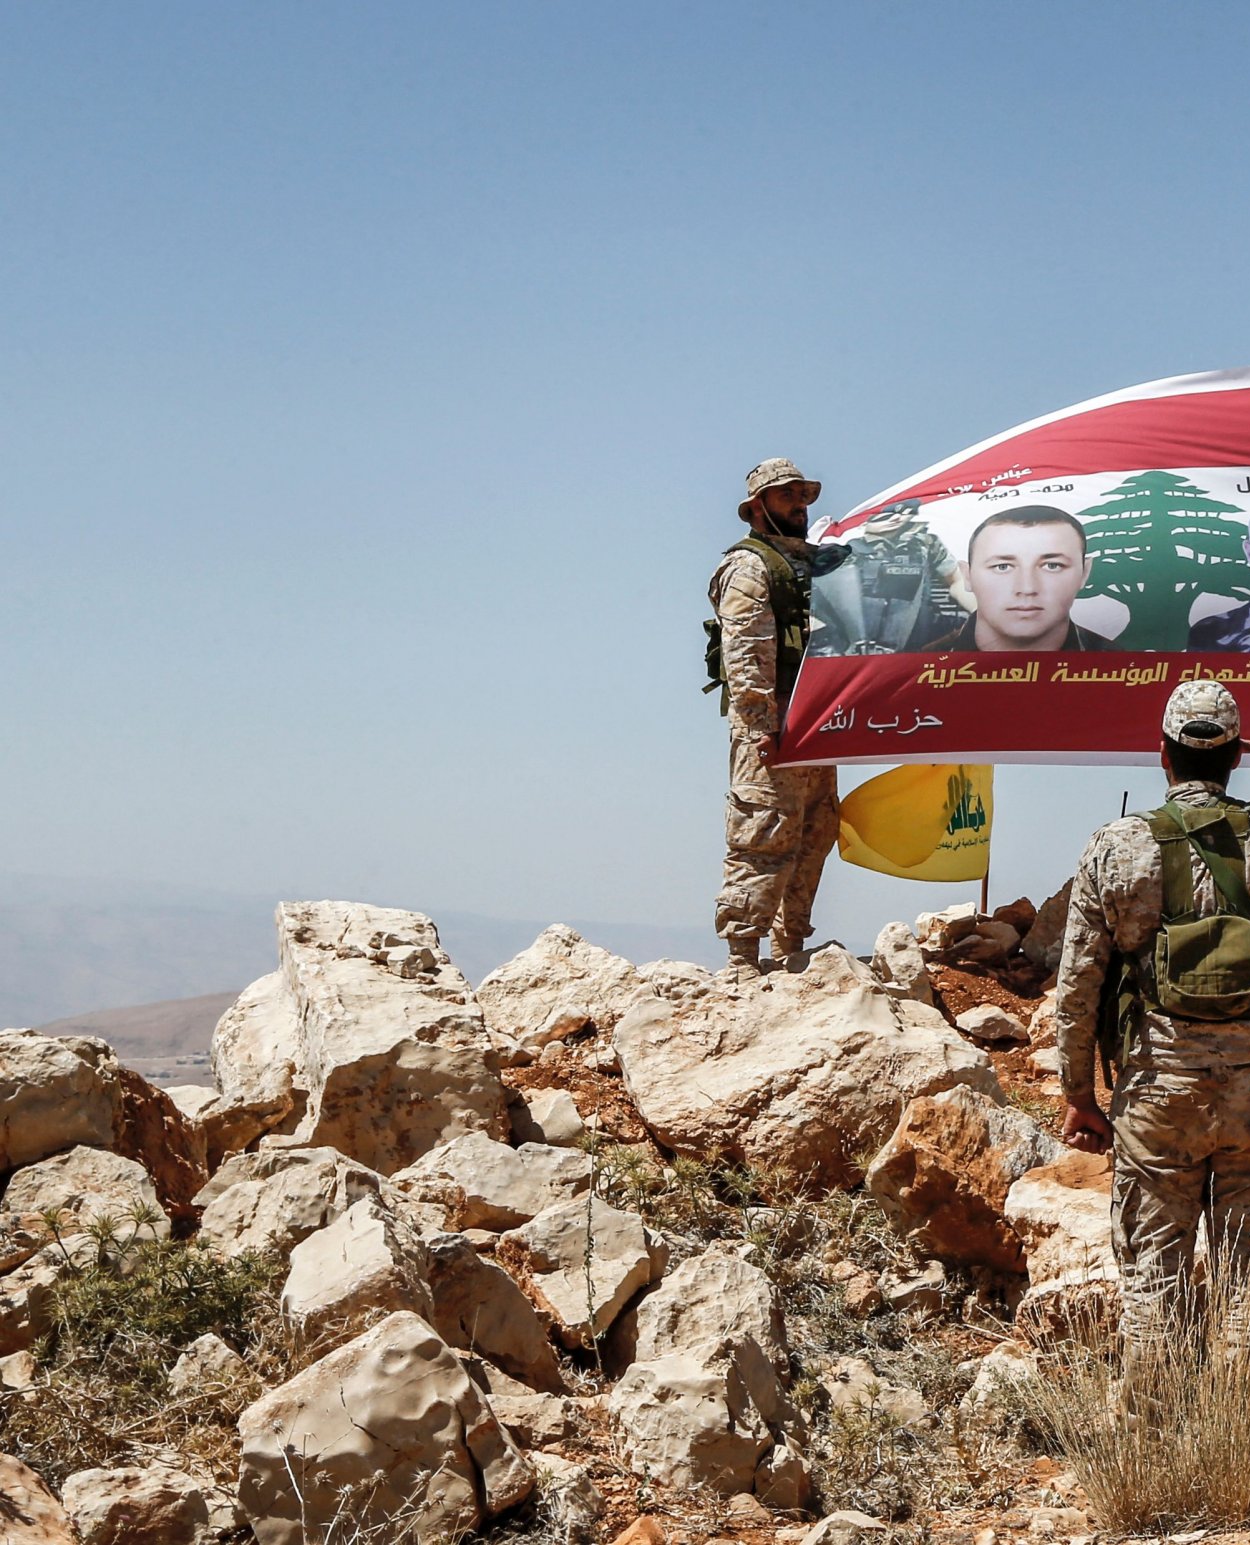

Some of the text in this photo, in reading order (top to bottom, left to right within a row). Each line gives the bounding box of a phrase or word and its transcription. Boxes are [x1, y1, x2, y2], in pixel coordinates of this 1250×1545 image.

[1050, 661, 1169, 687] المؤسسة
[818, 704, 943, 735] حزب الله
